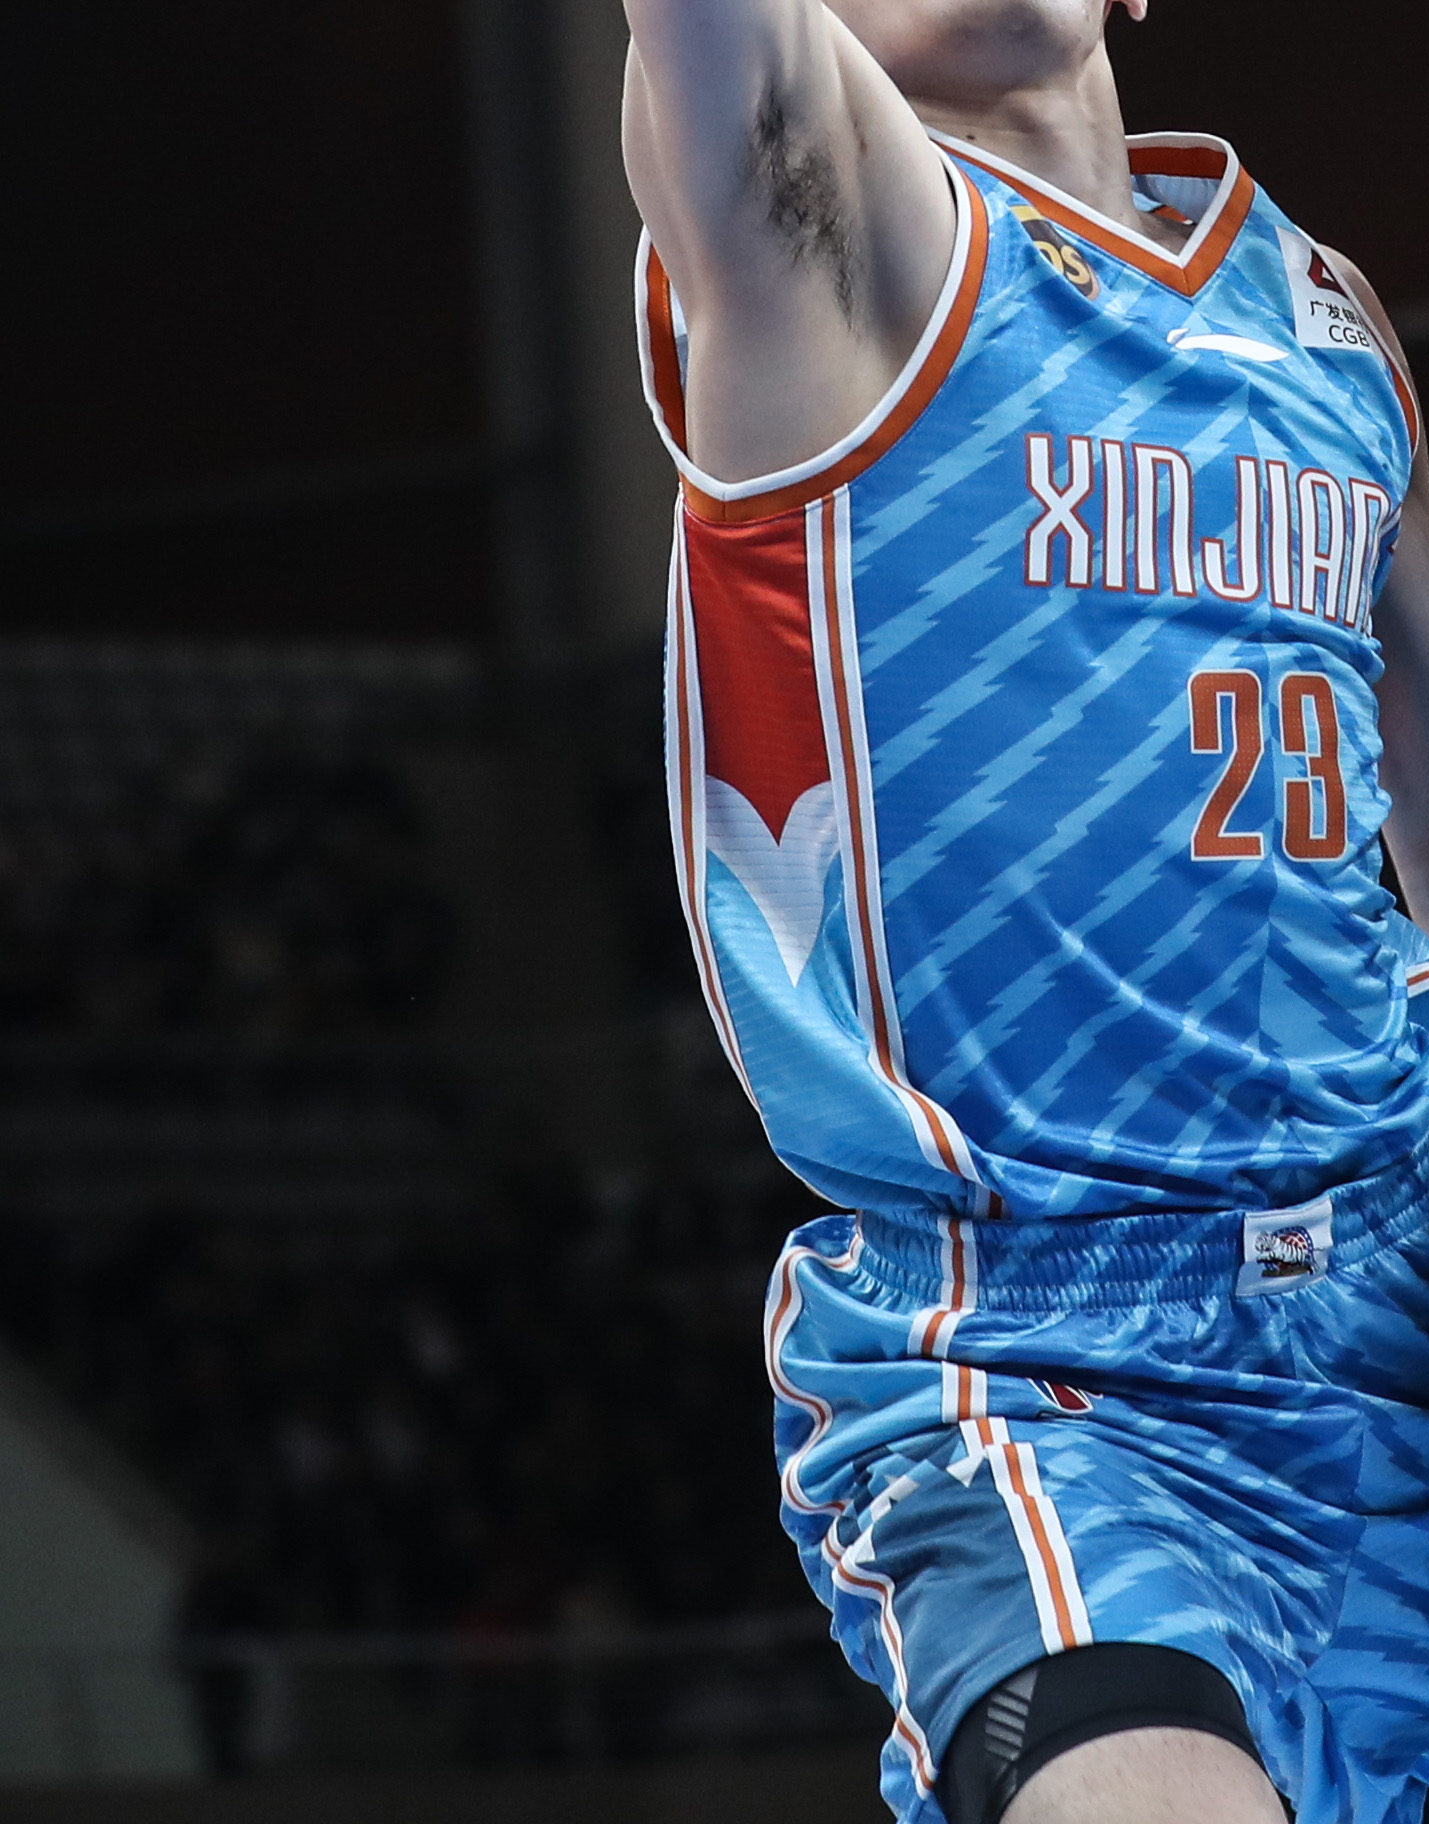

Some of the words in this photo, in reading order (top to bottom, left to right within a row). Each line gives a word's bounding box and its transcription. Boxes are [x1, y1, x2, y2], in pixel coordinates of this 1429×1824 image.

[1309, 300, 1369, 334] 广发银
[1328, 324, 1370, 347] CGB
[1024, 432, 1401, 633] XINJIAN
[1187, 668, 1349, 863] 23
